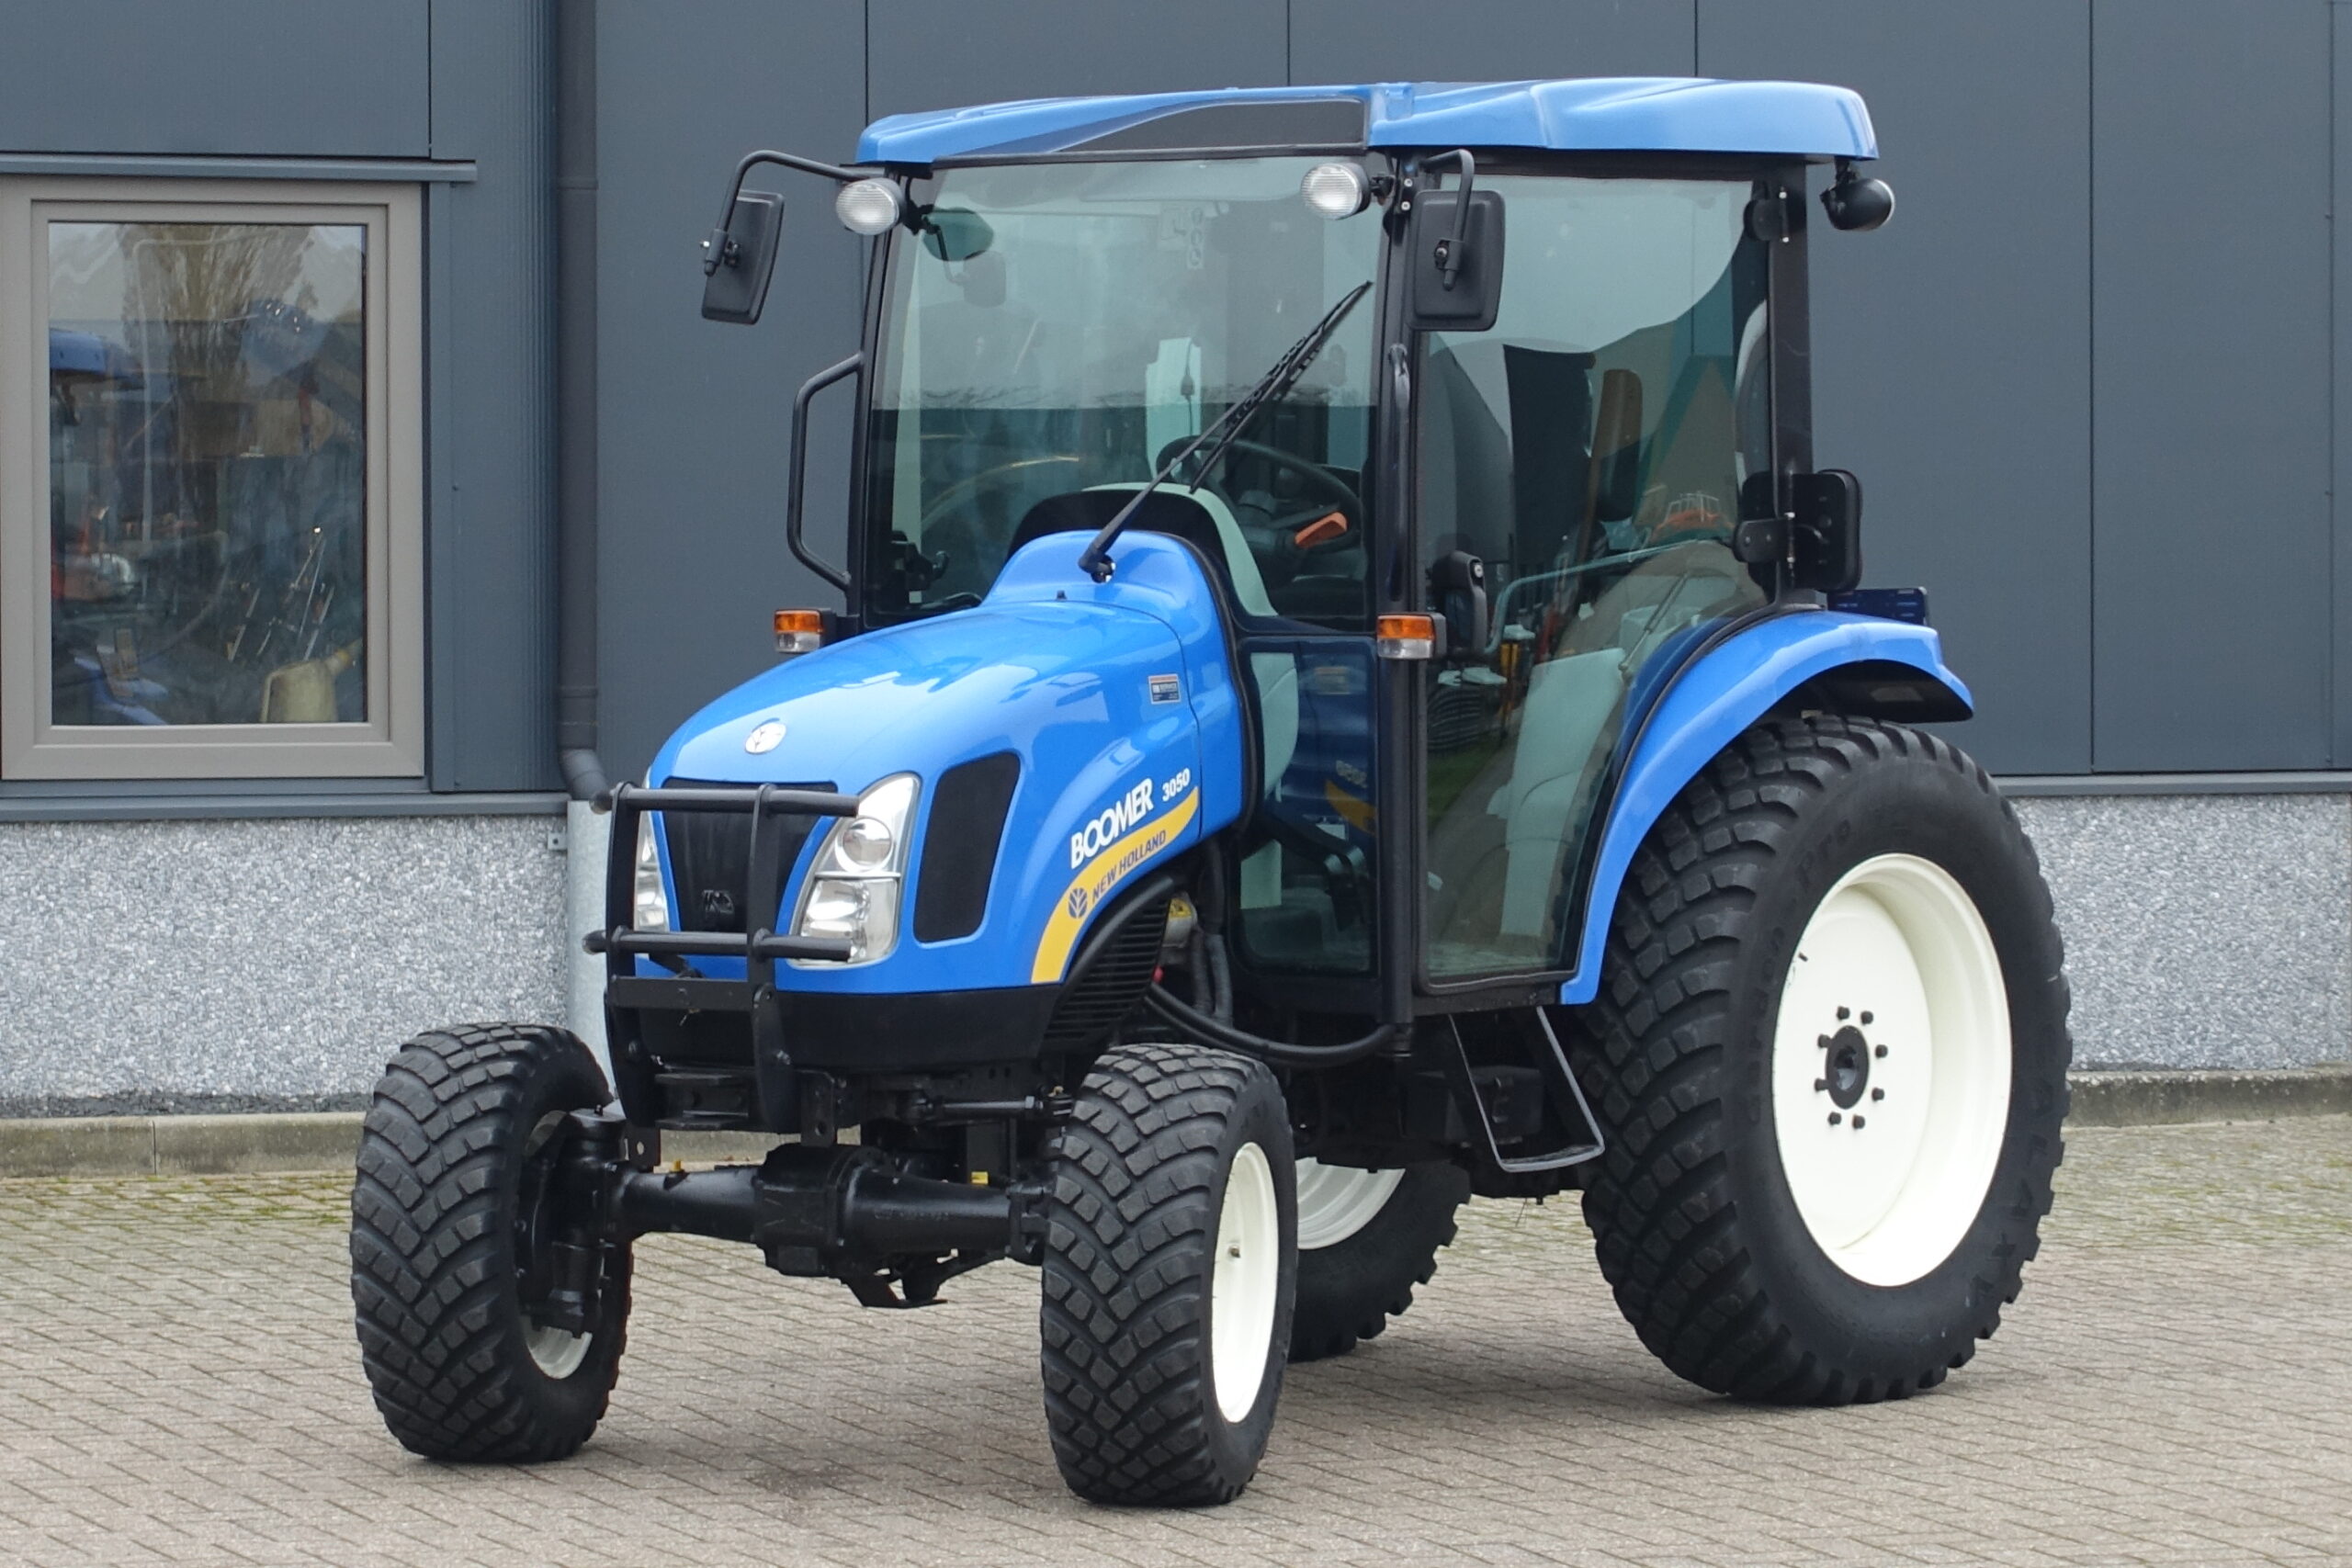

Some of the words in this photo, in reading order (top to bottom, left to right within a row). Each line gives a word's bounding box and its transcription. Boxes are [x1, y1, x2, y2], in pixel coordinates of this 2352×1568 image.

[1071, 778, 1154, 869] BOOMER
[1162, 768, 1191, 802] 3050
[1092, 865, 1117, 904] NEW
[1119, 829, 1166, 874] HOLLAND
